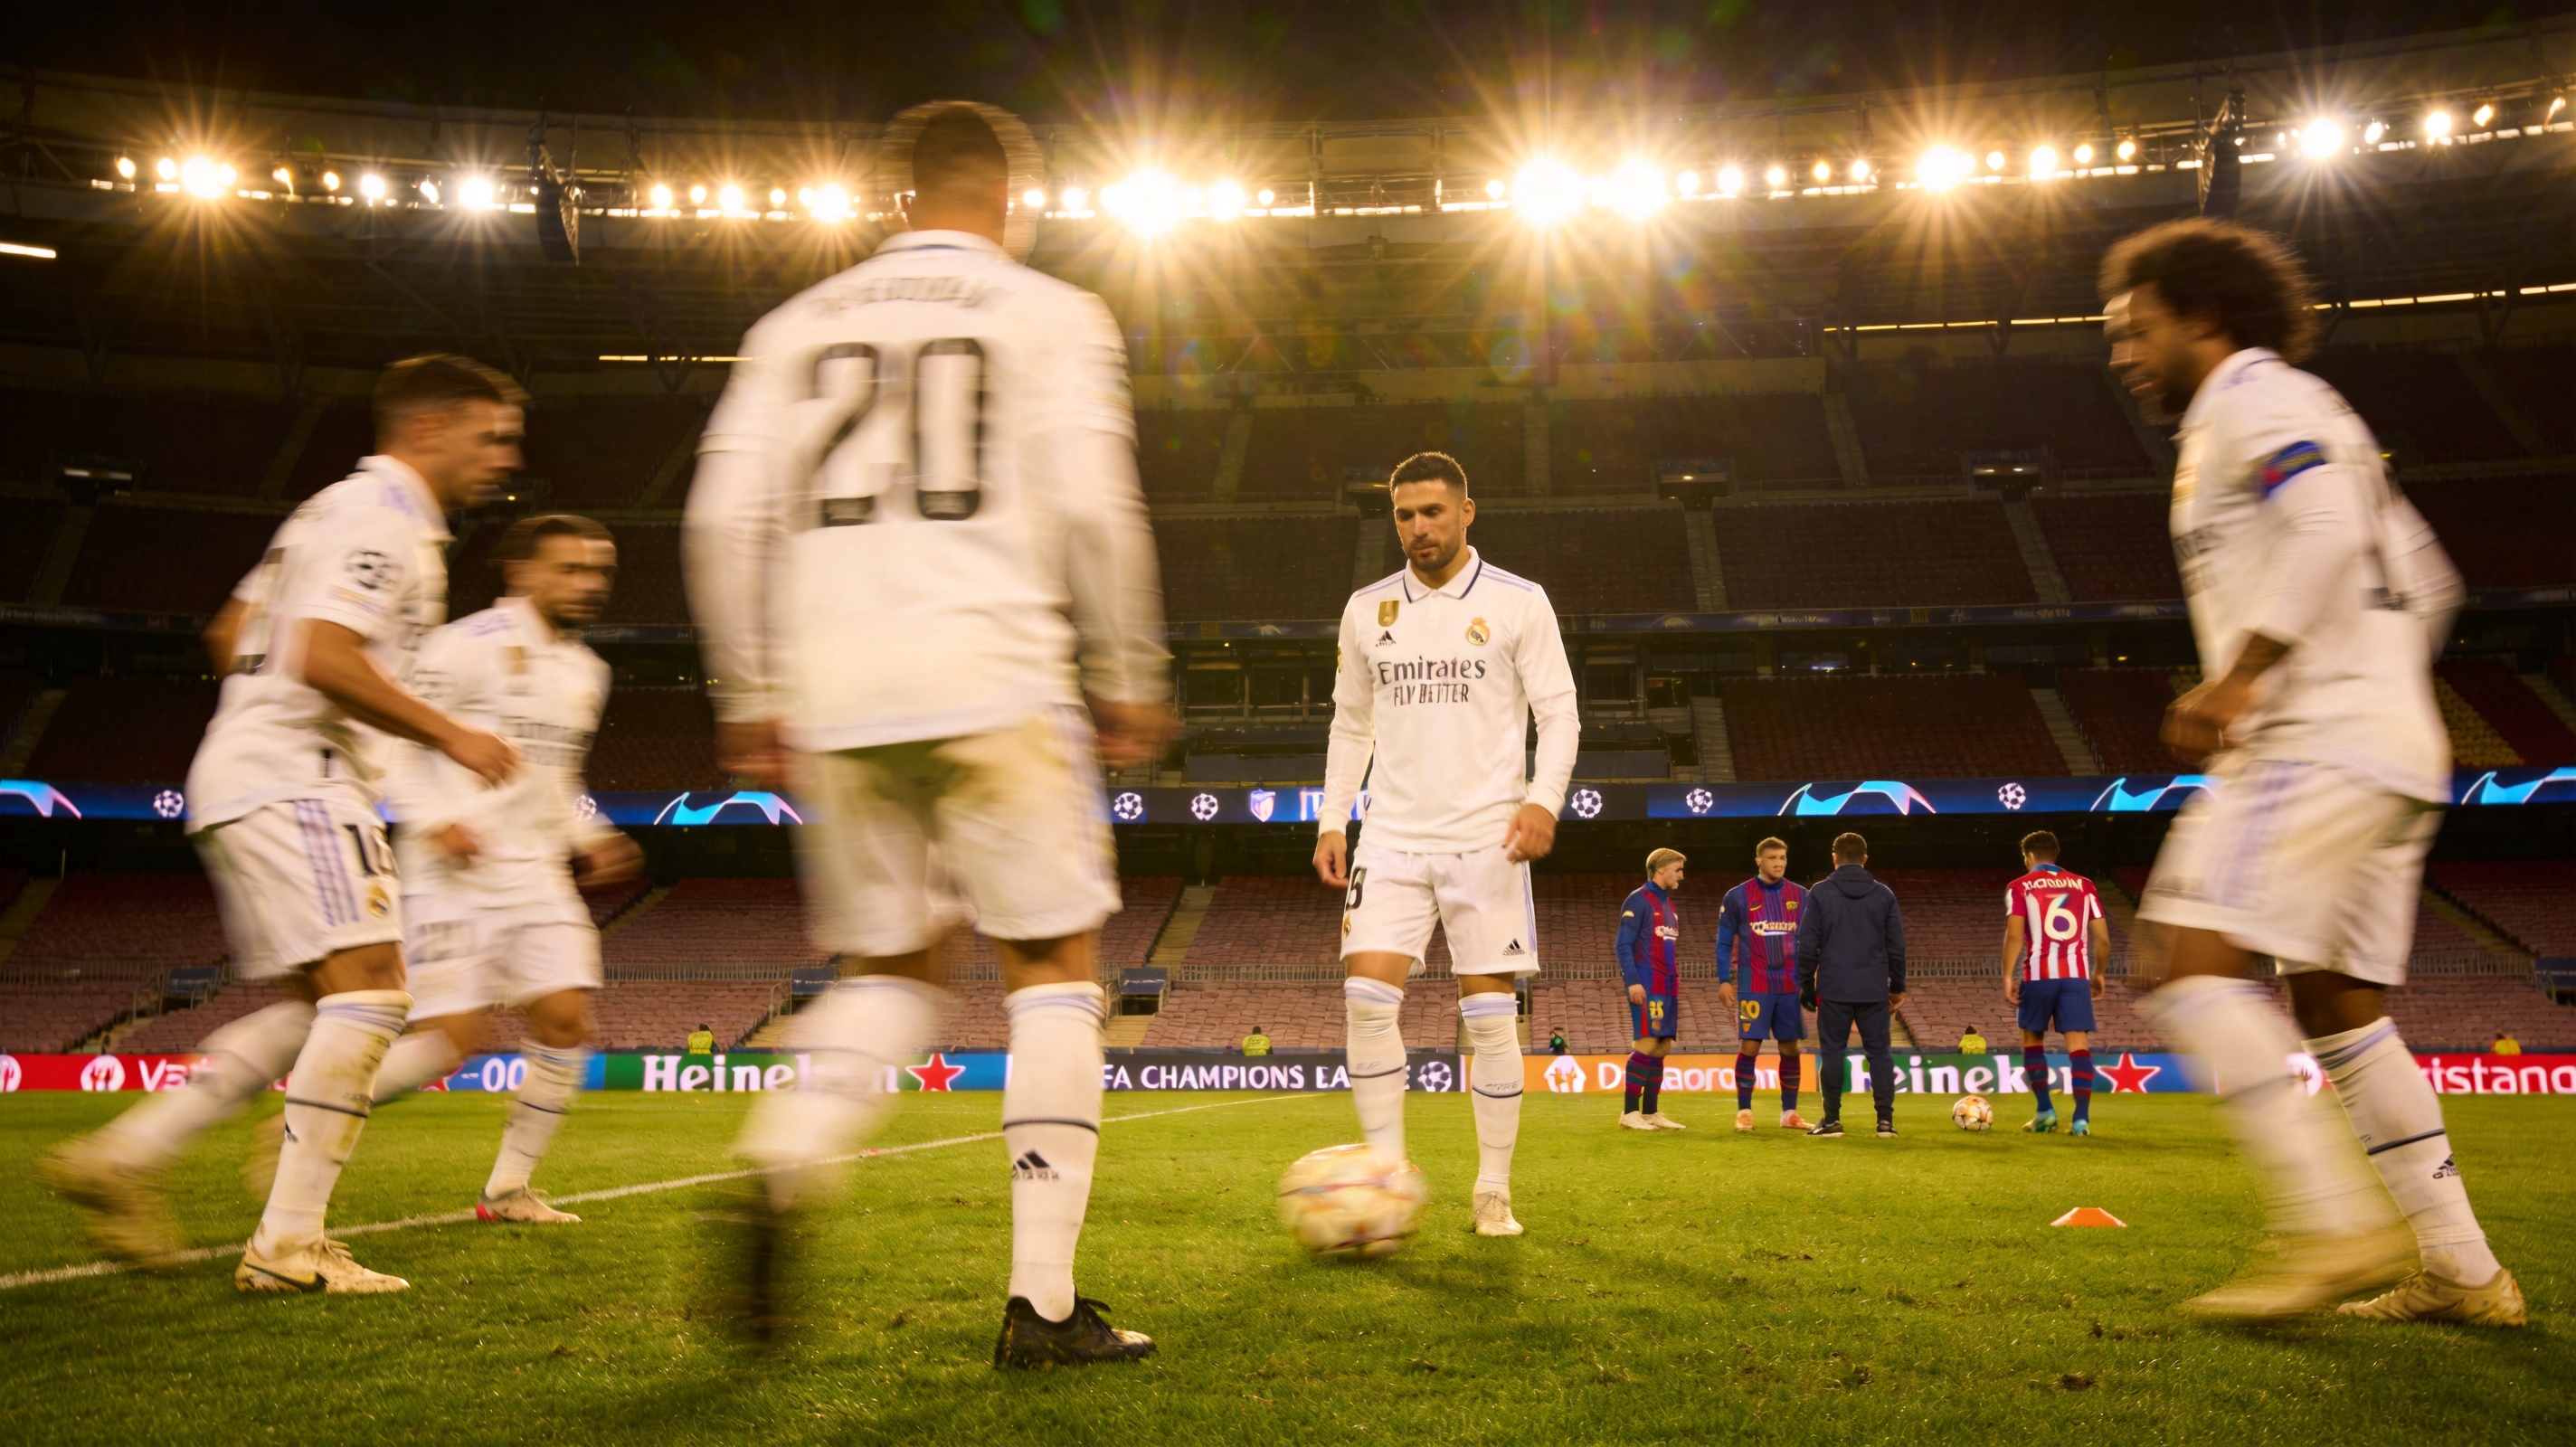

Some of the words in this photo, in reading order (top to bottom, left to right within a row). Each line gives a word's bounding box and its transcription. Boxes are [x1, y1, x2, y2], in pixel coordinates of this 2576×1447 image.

[794, 337, 988, 525] 20
[1378, 655, 1486, 685] Emirates
[1394, 686, 1416, 707] FLY
[2044, 894, 2078, 941] 6
[633, 1054, 900, 1092] Heinen
[1140, 1064, 1305, 1090] CHAMPIONS
